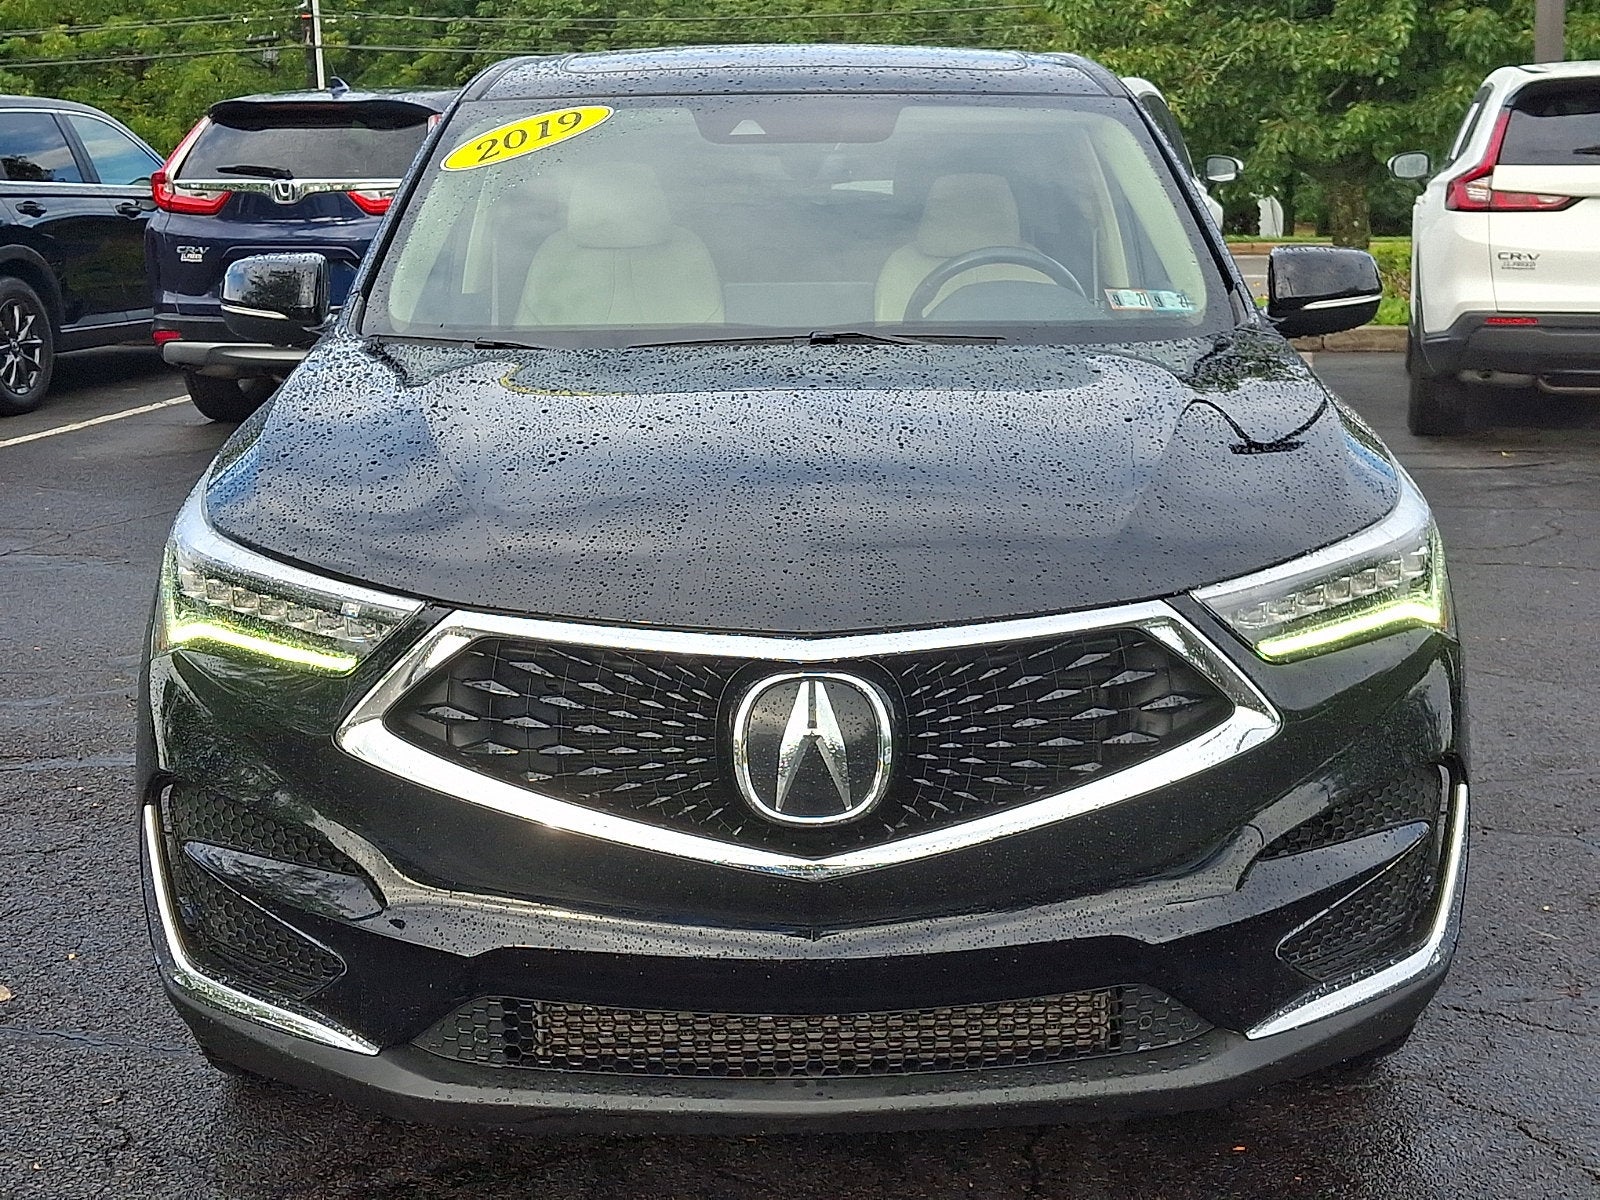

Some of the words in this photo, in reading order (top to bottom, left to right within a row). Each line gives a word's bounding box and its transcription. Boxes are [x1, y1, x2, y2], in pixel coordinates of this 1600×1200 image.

[476, 111, 582, 162] 2019
[176, 245, 211, 255] CR-V
[1497, 251, 1541, 261] CR-V
